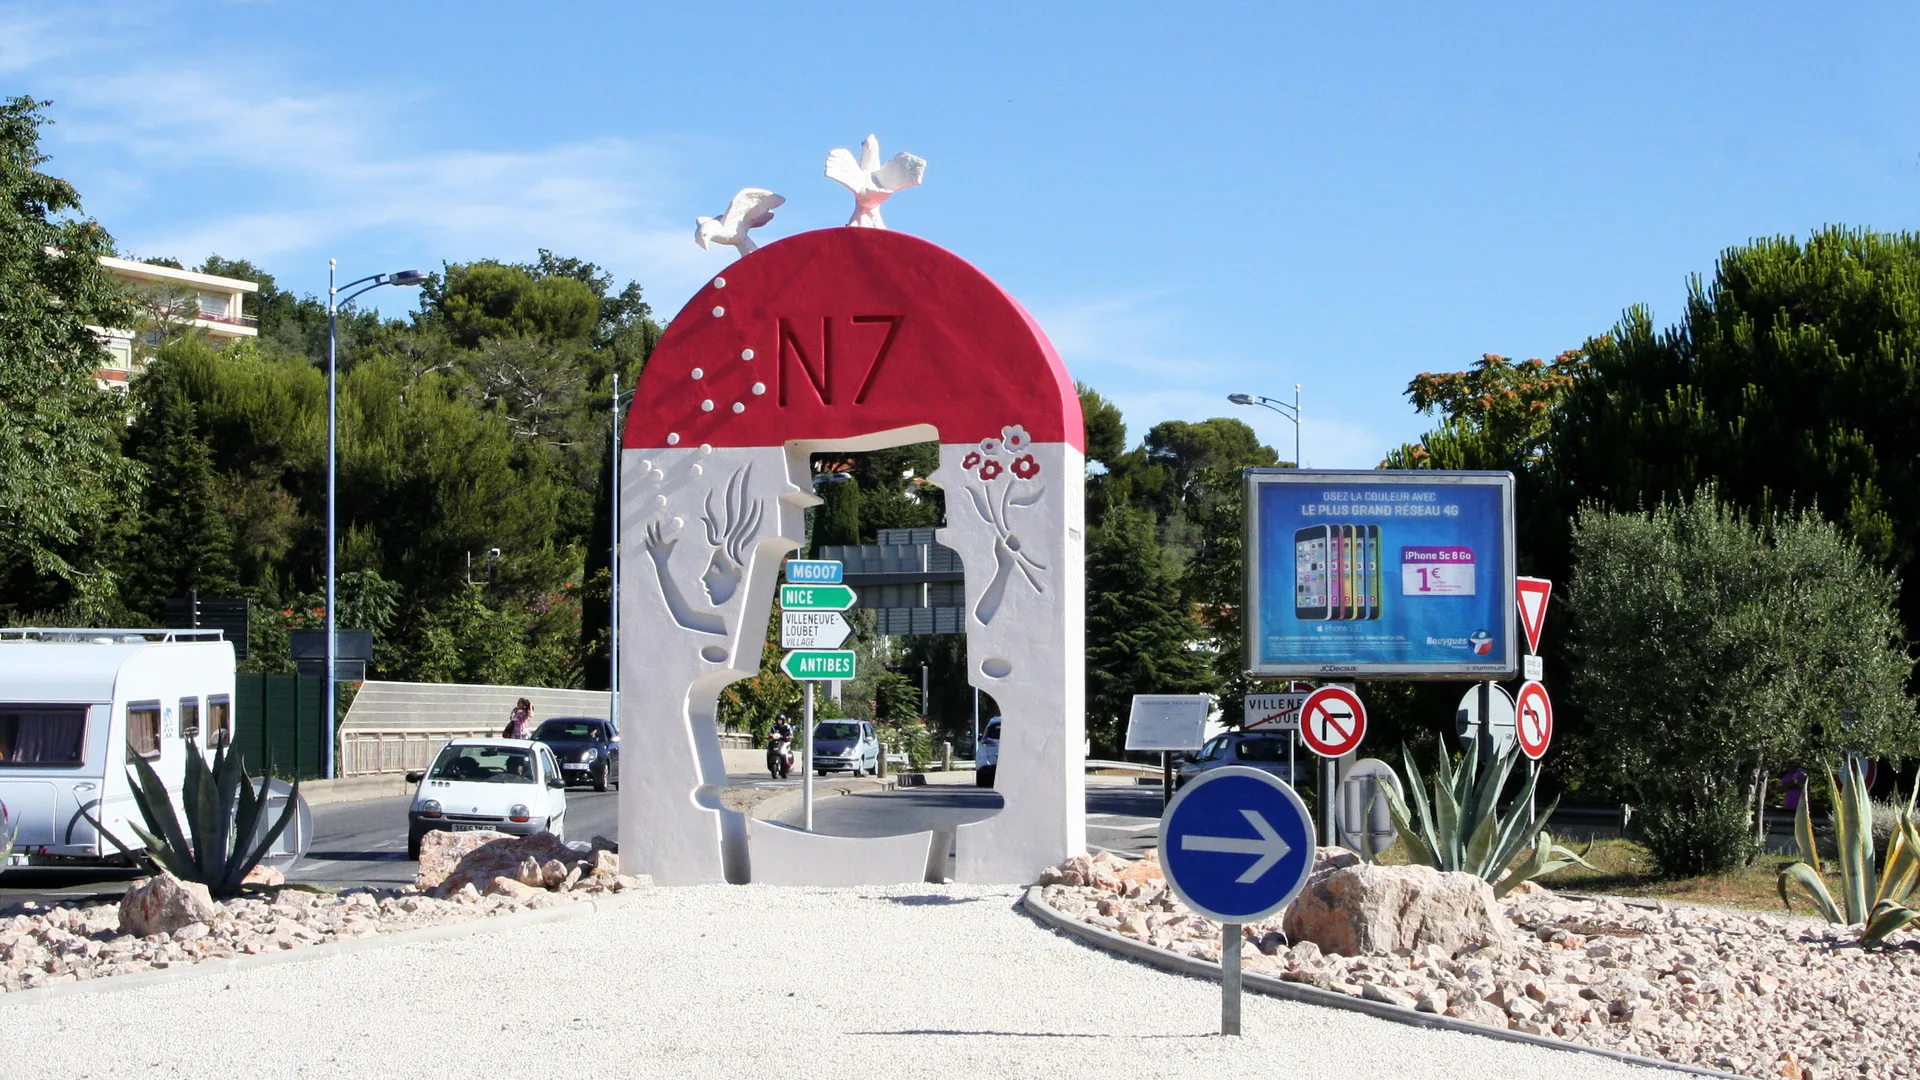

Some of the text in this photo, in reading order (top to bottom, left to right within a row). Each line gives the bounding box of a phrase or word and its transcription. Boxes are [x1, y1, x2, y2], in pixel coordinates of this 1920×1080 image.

[1323, 491, 1436, 501] OSEZ LA COULEUR AVEC
[1302, 503, 1459, 516] LE PLUS GRAND RÉSEAU 4G
[1405, 551, 1472, 560] iPhone 5c 8 Go
[793, 564, 837, 579] M6007
[786, 590, 814, 604] NICE
[785, 614, 839, 625] VILLENEUVE-
[785, 625, 819, 637] LOUBET
[785, 637, 815, 647] VILLAGE
[1426, 636, 1468, 647] Bouygues
[800, 657, 850, 672] ANTIBES
